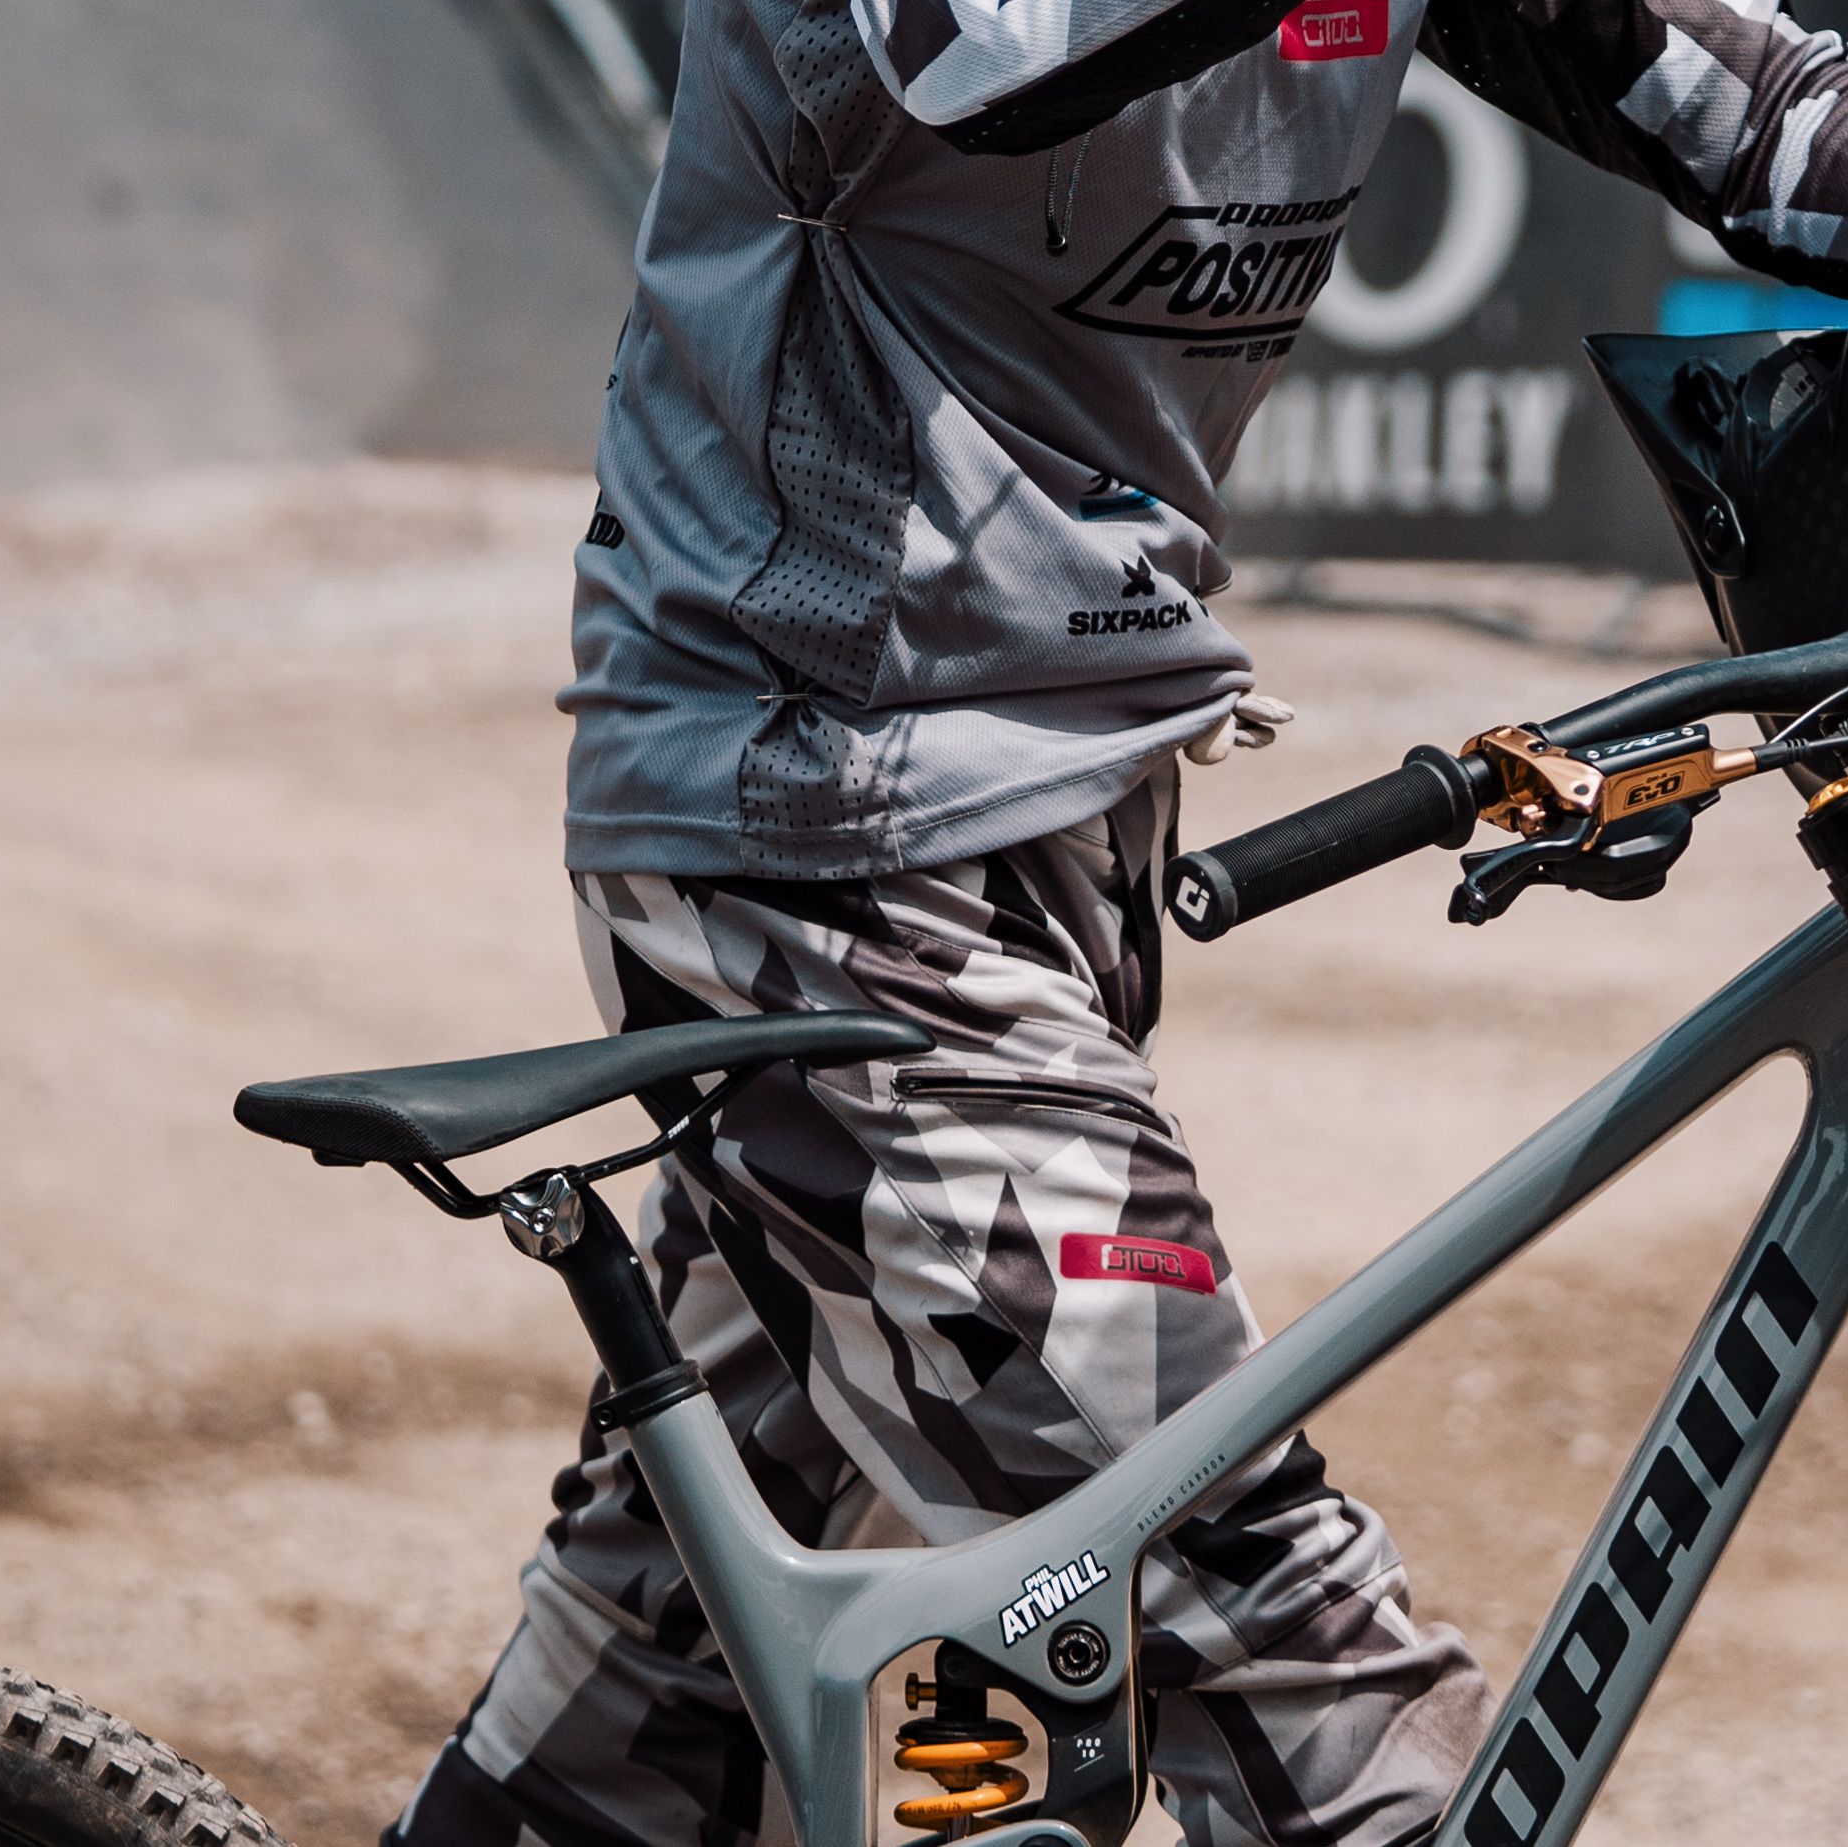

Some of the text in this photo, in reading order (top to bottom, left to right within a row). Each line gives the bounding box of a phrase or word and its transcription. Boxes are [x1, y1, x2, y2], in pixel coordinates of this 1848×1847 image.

[1067, 600, 1192, 637] SIXPACK
[1606, 731, 1676, 754] TRP
[1627, 774, 1682, 806] EVO
[1137, 1452, 1226, 1532] BLEND CARBON
[1025, 1567, 1054, 1593] PHIL
[1002, 1552, 1108, 1645] ATWILL
[1076, 1737, 1102, 1748] PRO
